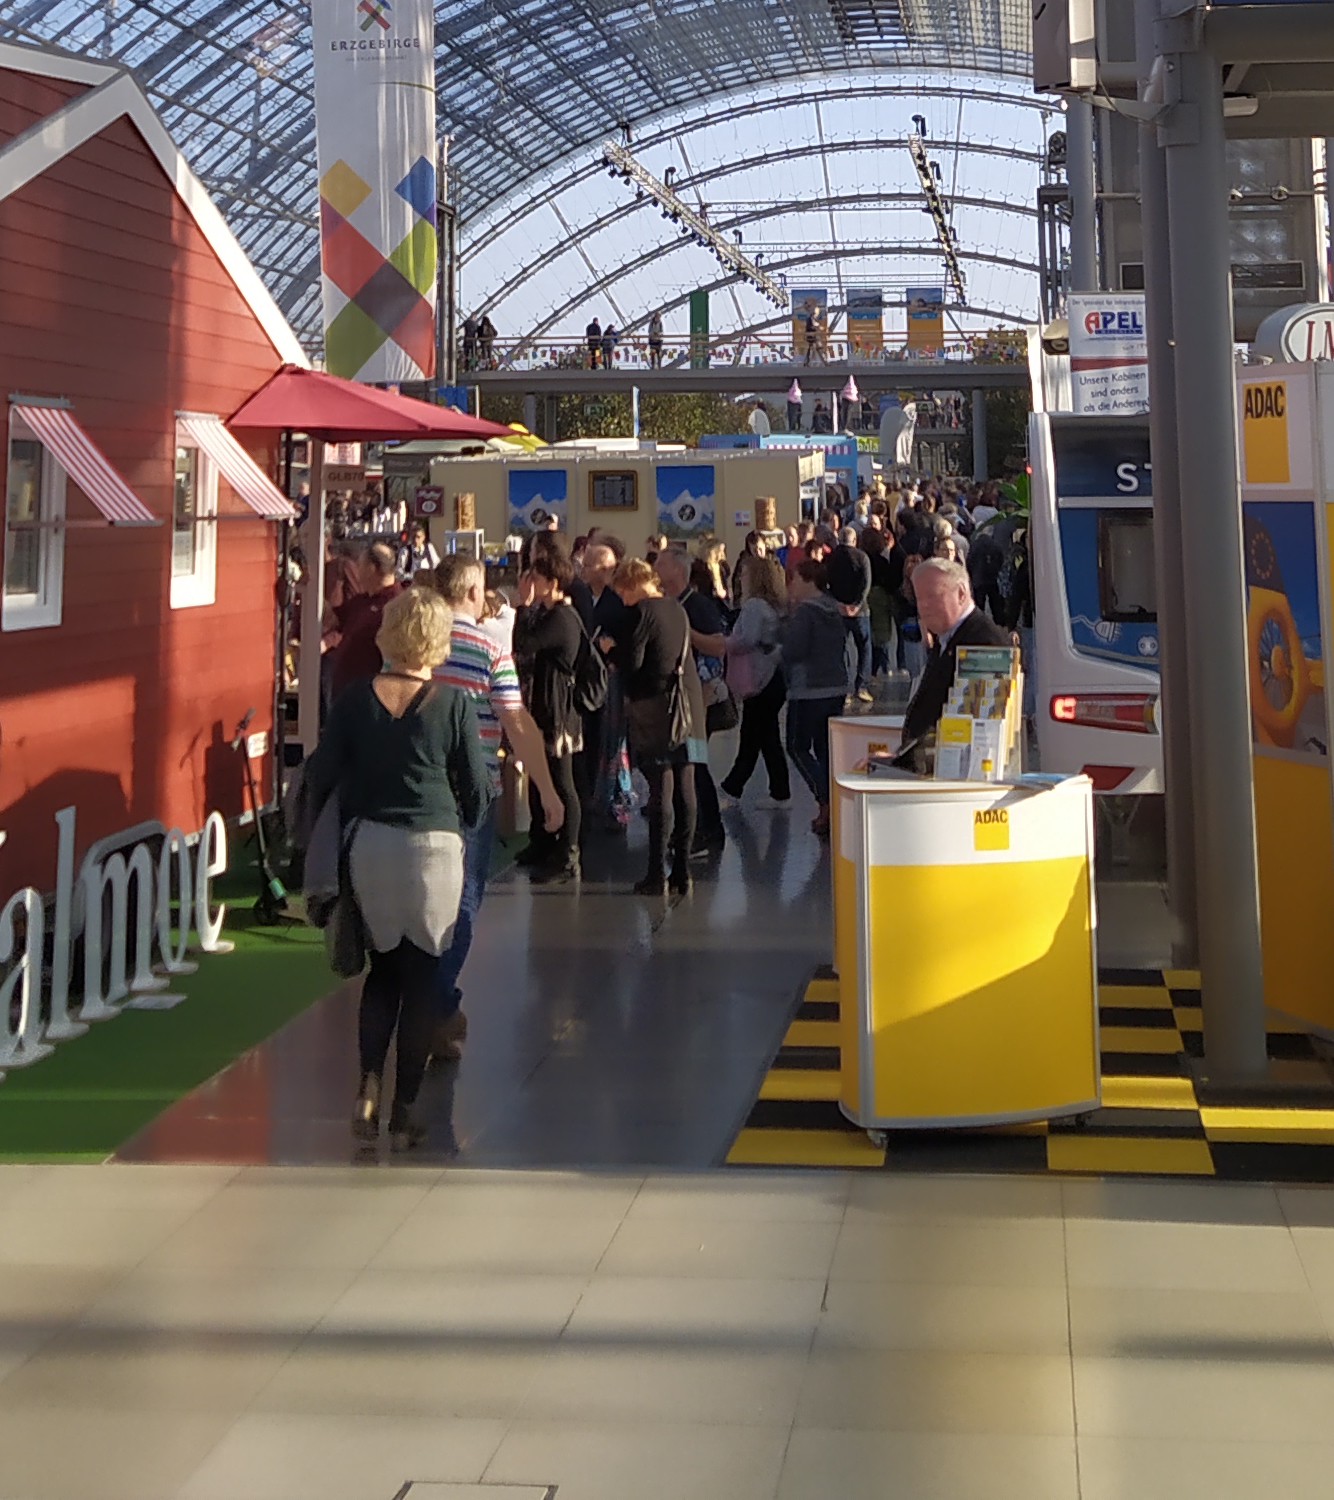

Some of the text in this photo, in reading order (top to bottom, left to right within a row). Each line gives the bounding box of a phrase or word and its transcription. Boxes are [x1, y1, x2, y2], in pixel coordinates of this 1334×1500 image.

[330, 37, 421, 52] ERZGEBIRGE
[1084, 311, 1144, 335] APEL
[1079, 371, 1146, 385] Unsere Kabinen
[1090, 386, 1139, 398] sind anders
[1083, 403, 1095, 413] als
[1097, 402, 1110, 411] die
[1243, 385, 1286, 420] ADAC
[974, 809, 1008, 824] ADAC
